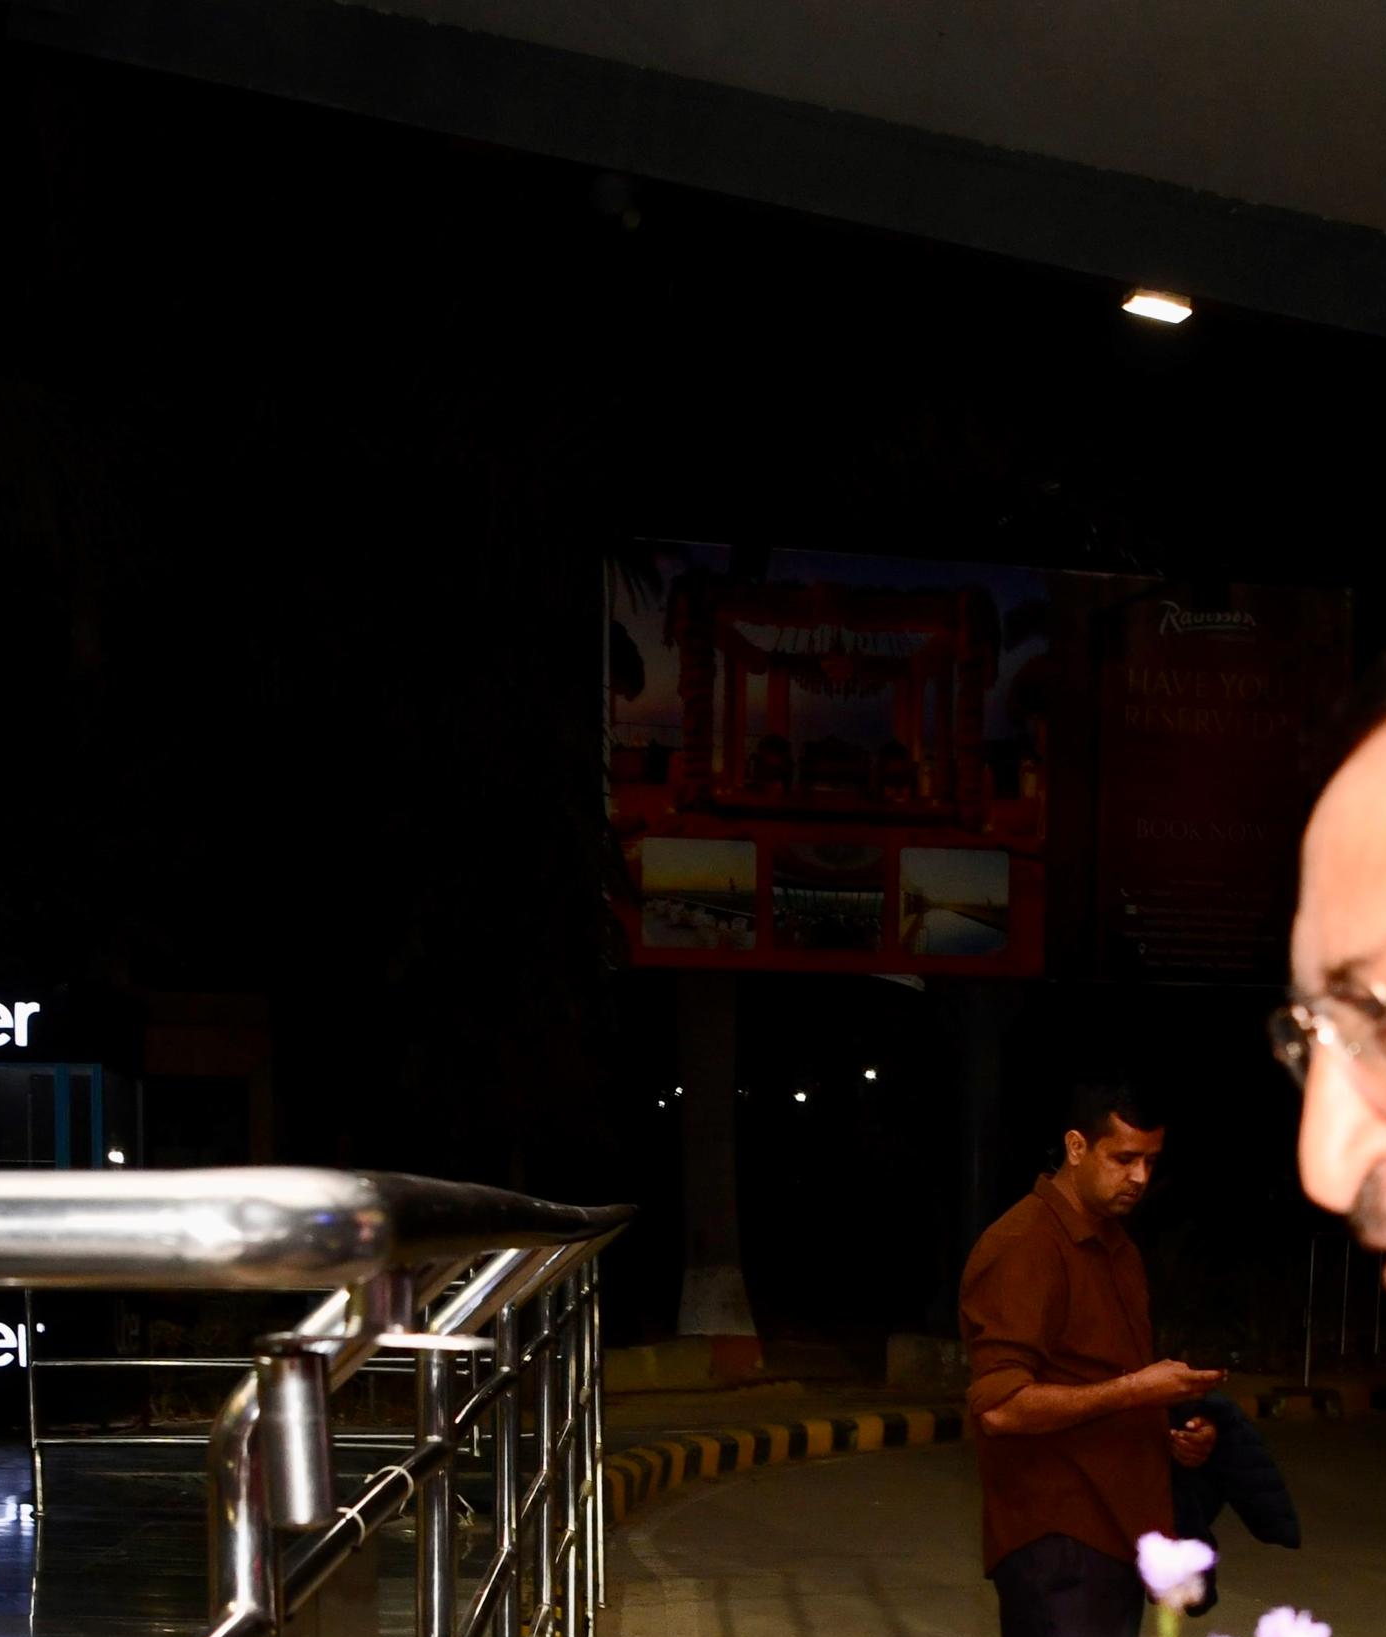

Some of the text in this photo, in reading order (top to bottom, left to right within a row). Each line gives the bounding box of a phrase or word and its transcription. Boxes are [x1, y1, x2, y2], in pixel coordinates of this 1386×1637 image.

[1128, 667, 1284, 703] HAVE YOU
[1137, 818, 1268, 843] BOOK NOW
